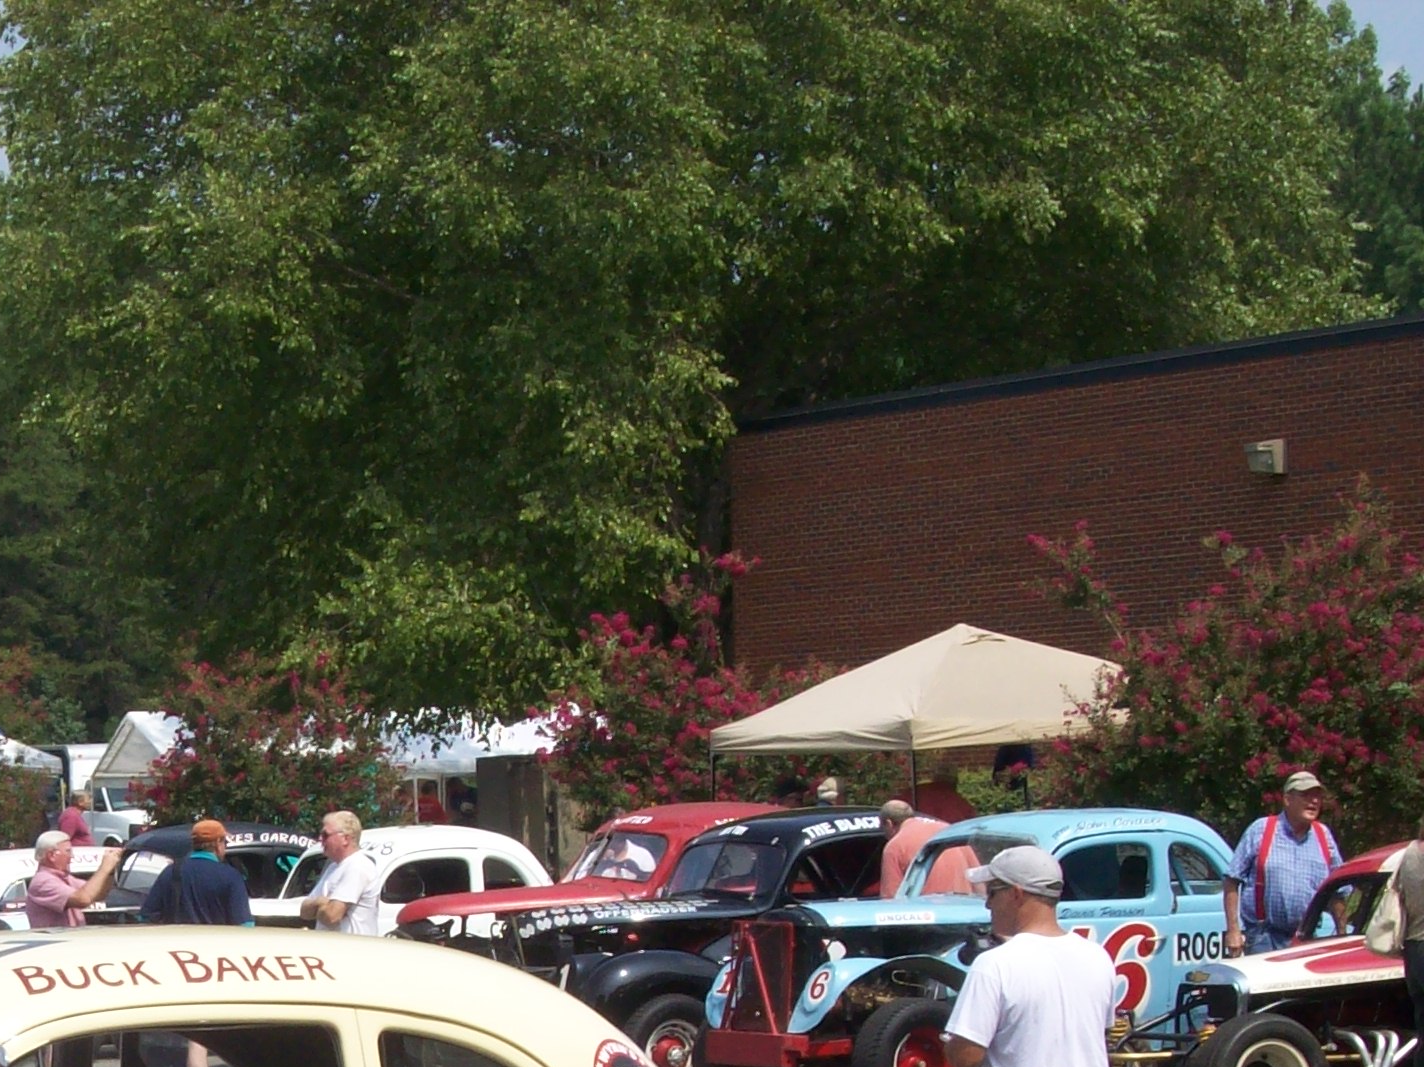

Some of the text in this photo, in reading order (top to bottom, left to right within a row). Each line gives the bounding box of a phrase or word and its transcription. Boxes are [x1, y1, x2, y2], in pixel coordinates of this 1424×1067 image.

[802, 821, 836, 838] THE
[878, 913, 922, 922] UNOCAL
[12, 950, 336, 995] BUCK BAKER
[1073, 923, 1158, 1010] 6
[809, 971, 829, 999] 6
